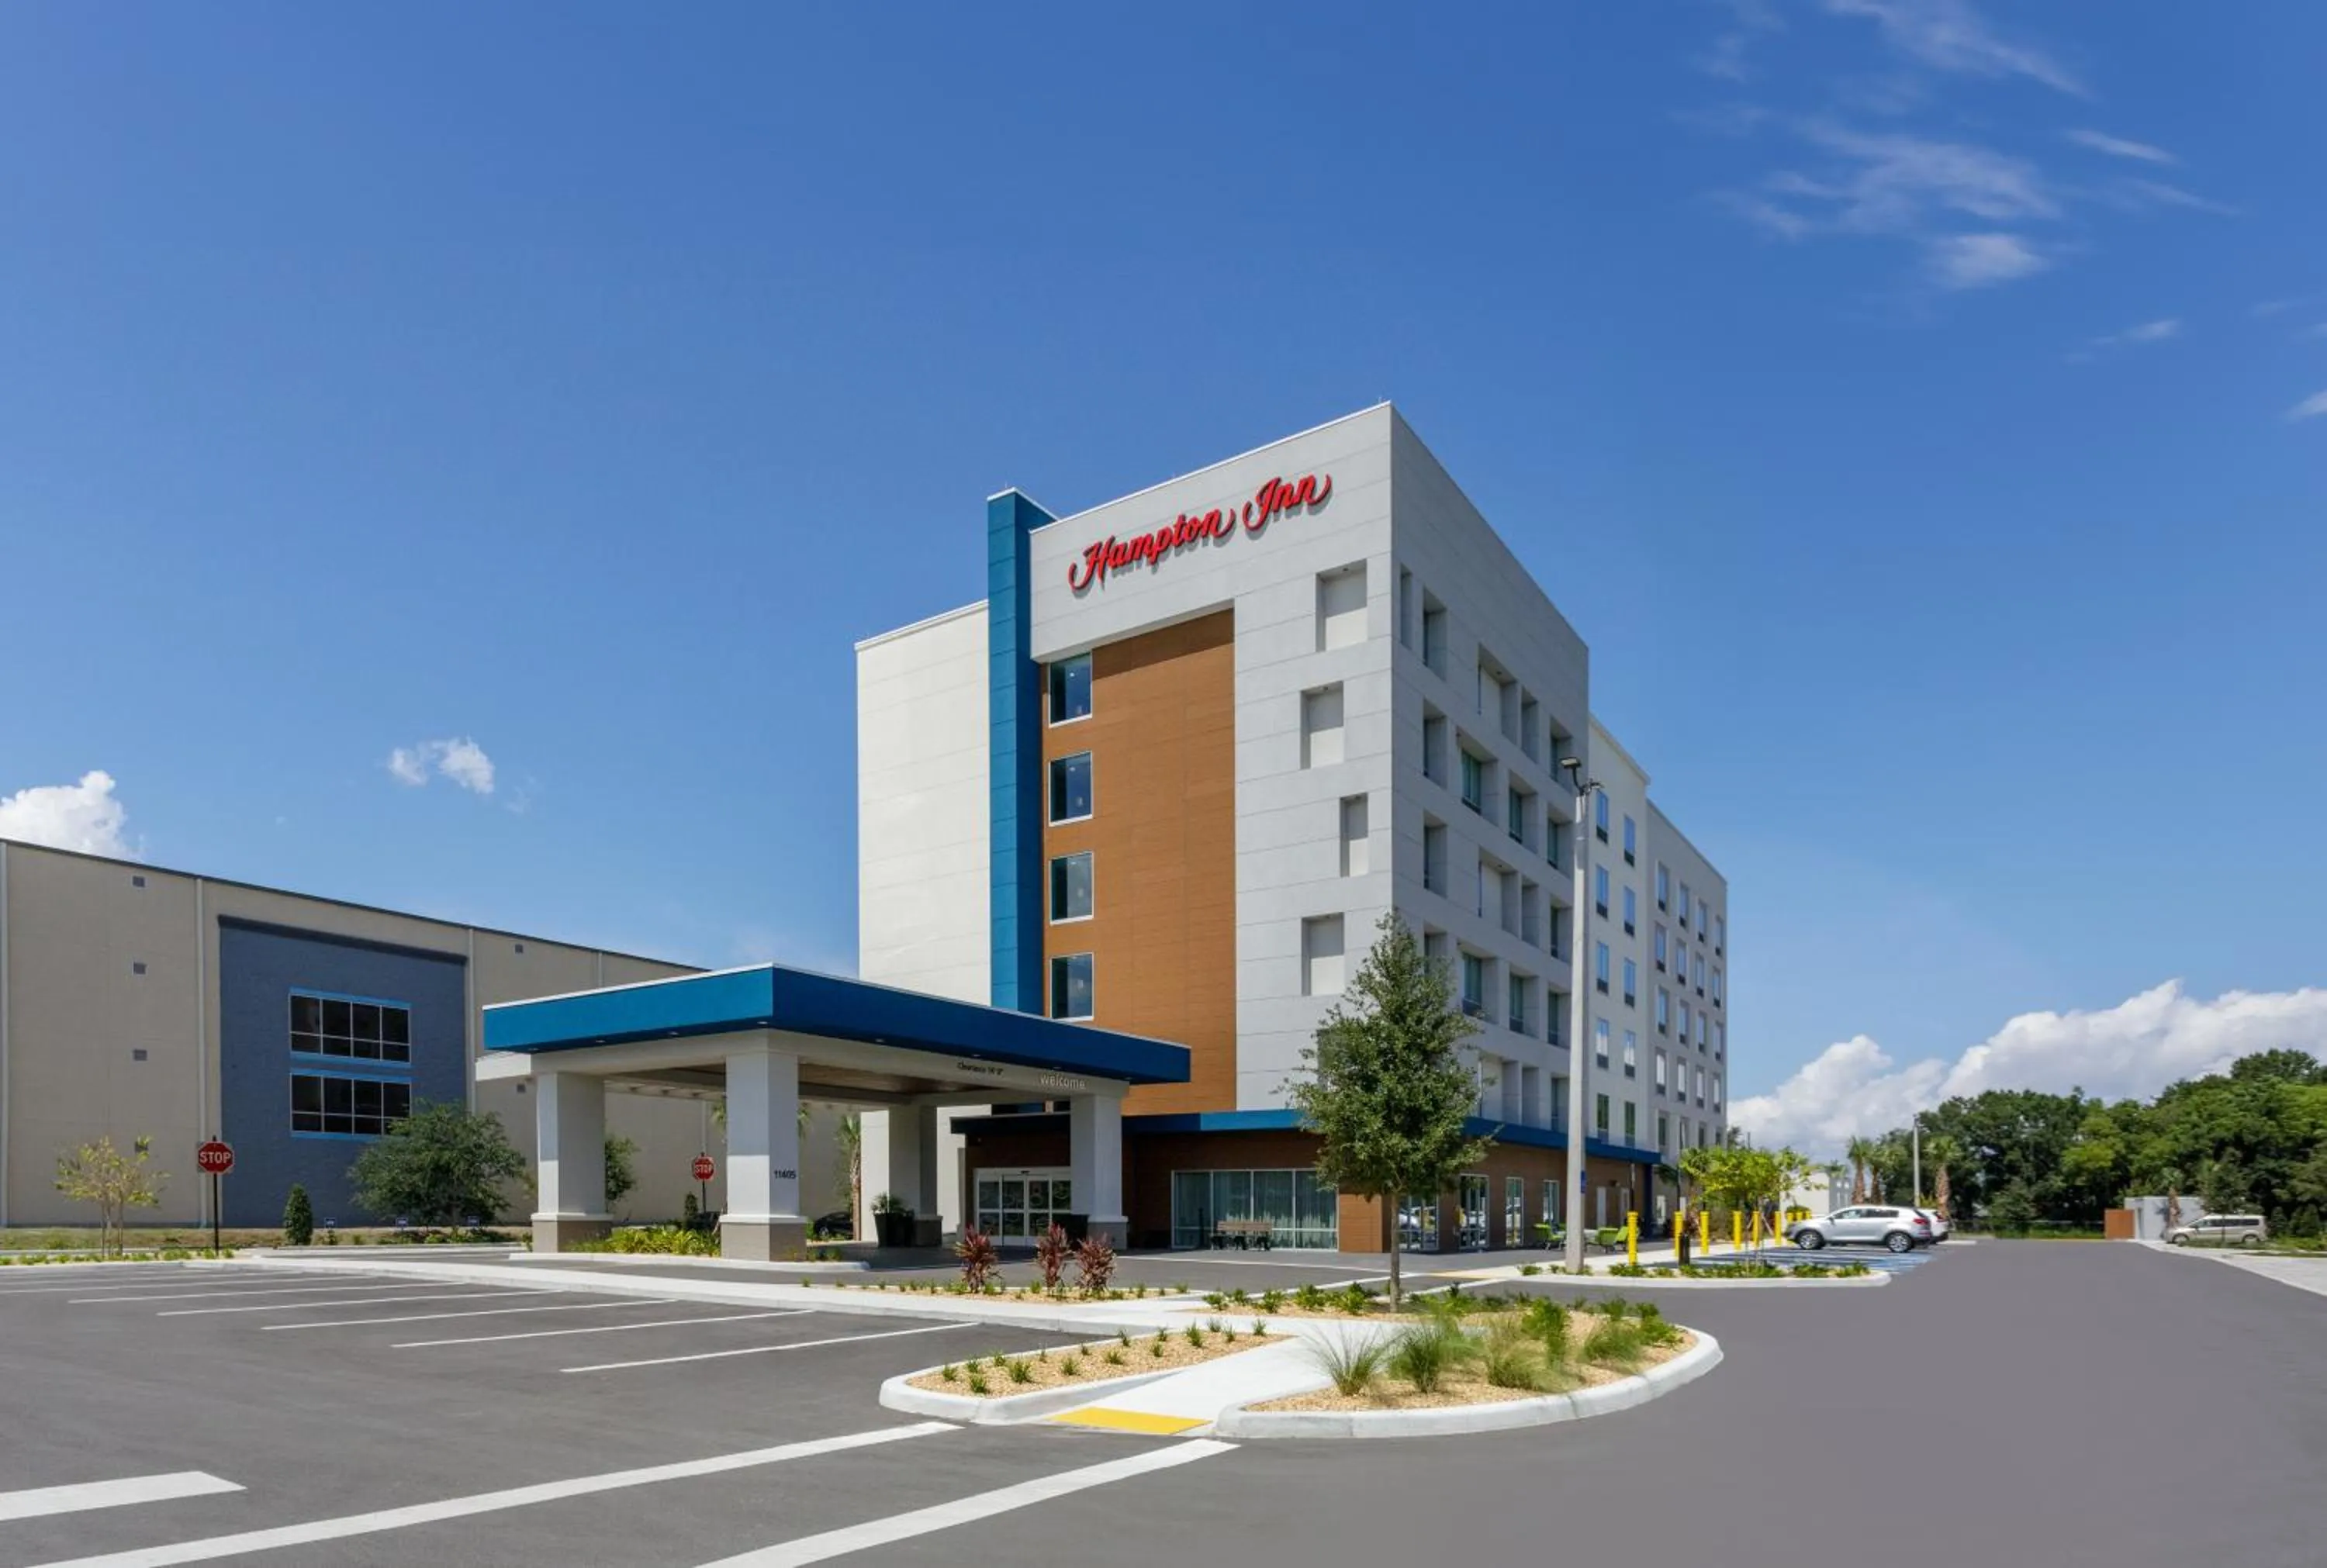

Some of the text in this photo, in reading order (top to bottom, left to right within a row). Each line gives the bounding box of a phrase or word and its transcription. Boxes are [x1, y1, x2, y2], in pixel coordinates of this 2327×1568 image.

[1067, 473, 1333, 591] Hampton Inn
[199, 1151, 232, 1164] STOP
[694, 1163, 714, 1174] STOP
